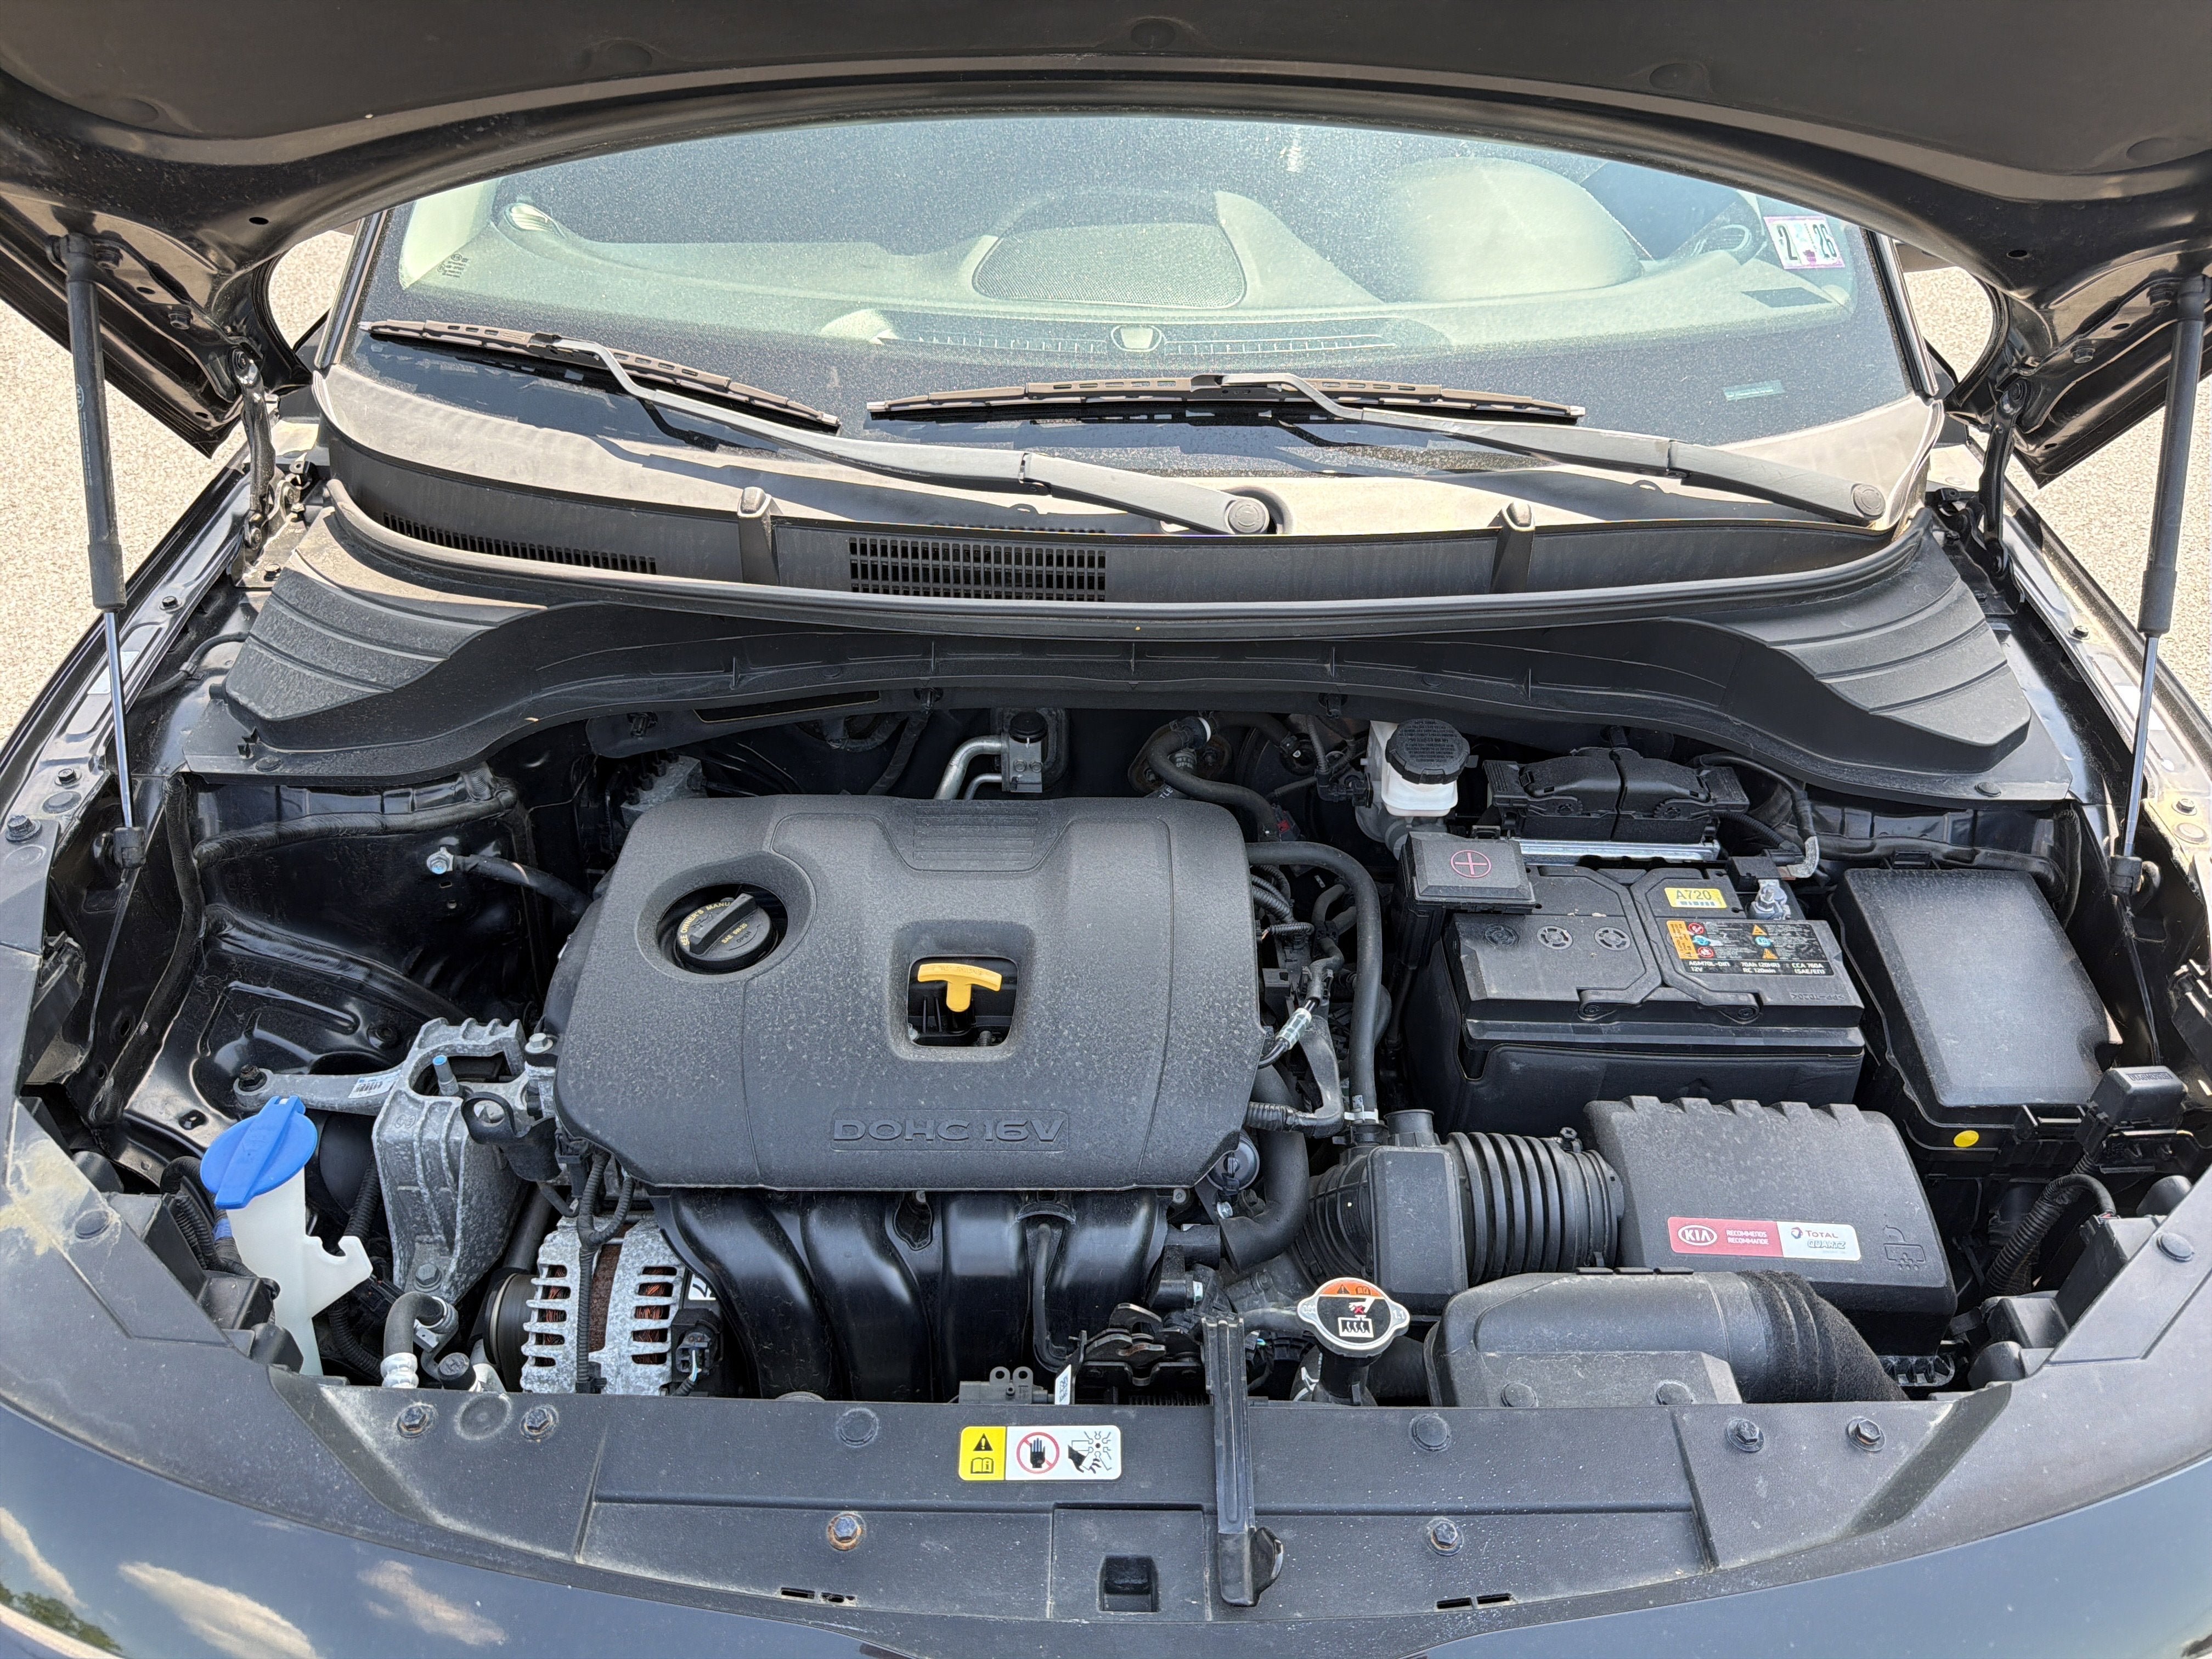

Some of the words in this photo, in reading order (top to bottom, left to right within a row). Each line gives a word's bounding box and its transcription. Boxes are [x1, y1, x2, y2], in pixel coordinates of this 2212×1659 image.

[1776, 225, 1798, 260] 2
[1676, 889, 1712, 900] A720
[706, 901, 730, 910] MANU
[680, 910, 704, 933] OWNER'S
[680, 934, 690, 945] SEE
[721, 934, 733, 943] SAE
[736, 931, 752, 943] OPEN
[833, 1119, 969, 1141] DOHC
[985, 1119, 1064, 1142] 16V
[1684, 1229, 1711, 1242] KIA
[1726, 1229, 1767, 1238] RECOMMENDS
[1805, 1230, 1839, 1238] TOTAL
[1807, 1239, 1846, 1249] QUARTZ
[1393, 1310, 1404, 1319] 1.1
